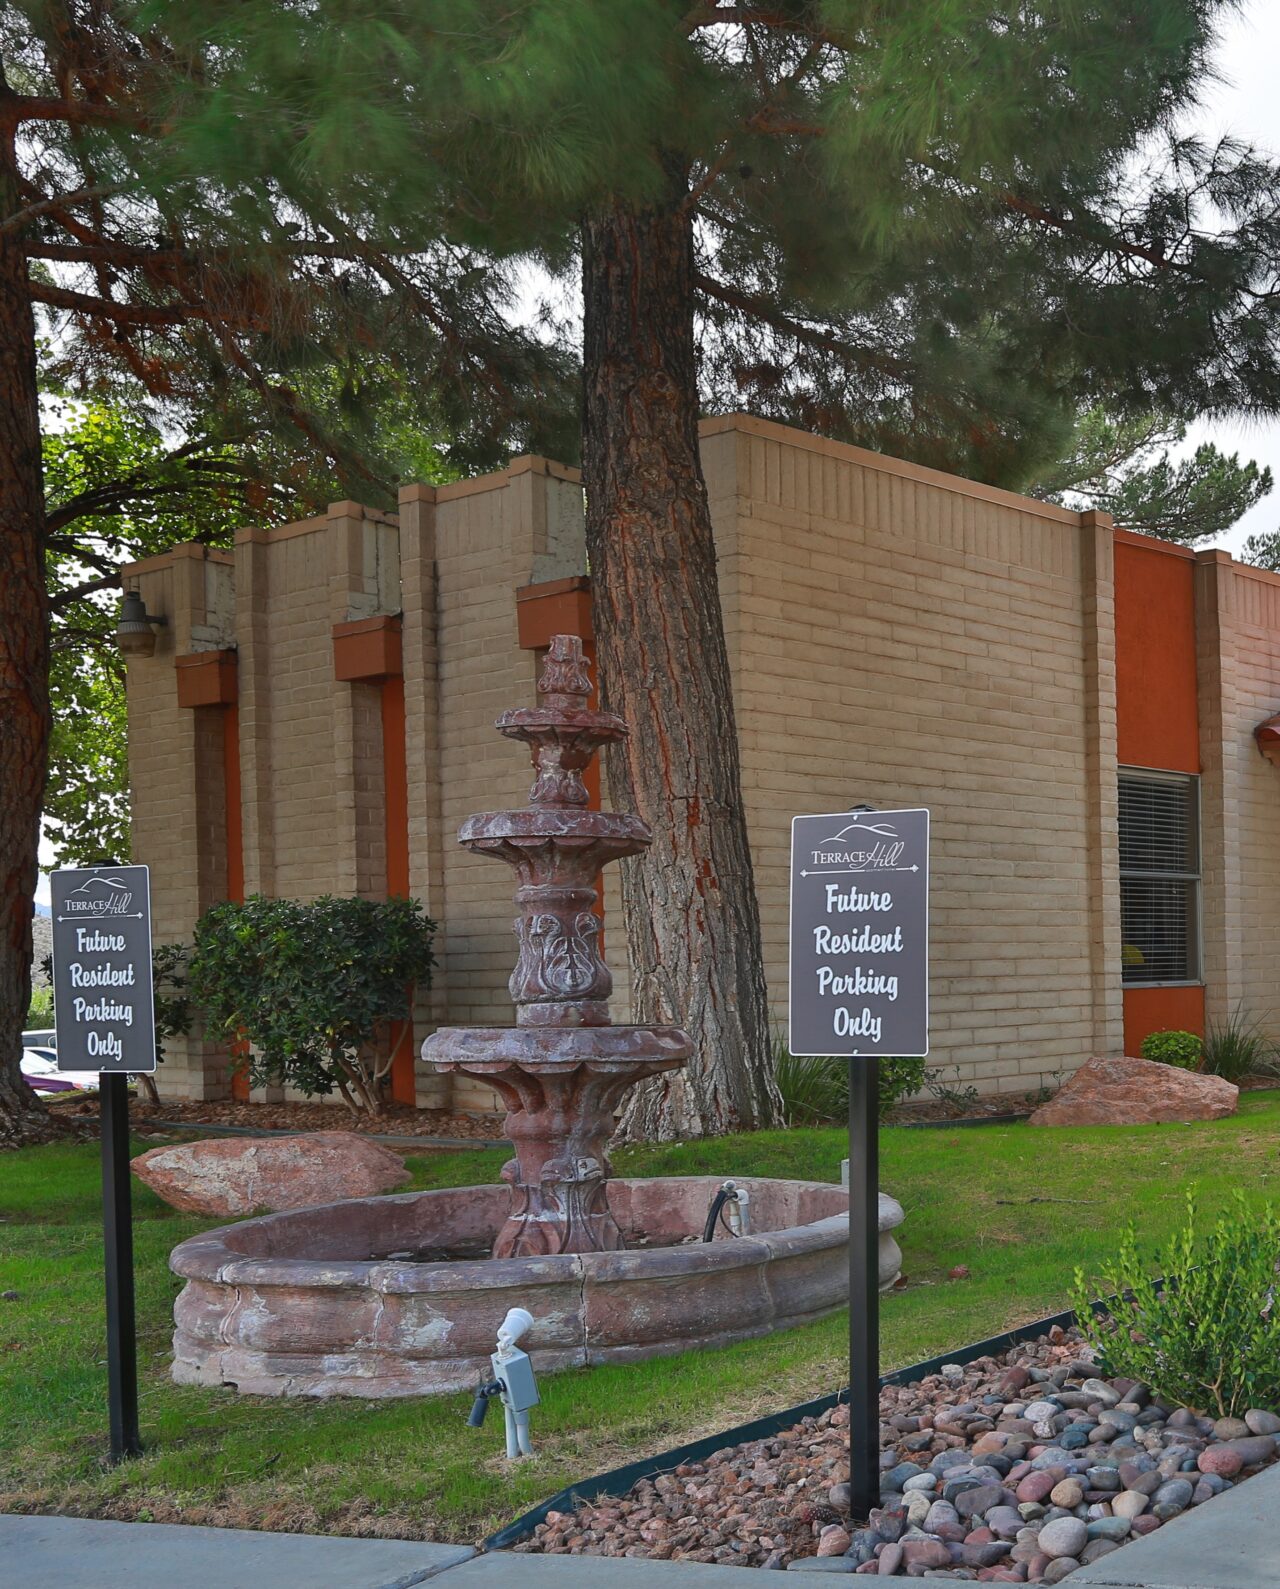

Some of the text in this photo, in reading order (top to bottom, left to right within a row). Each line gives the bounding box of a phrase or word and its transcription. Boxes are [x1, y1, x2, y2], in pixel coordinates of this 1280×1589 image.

[811, 841, 905, 870] TERRACE Hill
[64, 892, 132, 916] TERRACE Hill
[825, 884, 893, 913] Future
[76, 927, 126, 953] Future
[813, 924, 904, 955] Resident
[69, 962, 135, 988] Resident
[816, 966, 898, 1001] Parking
[73, 997, 133, 1026] Parking
[833, 1006, 882, 1043] Only
[87, 1031, 123, 1062] Only
